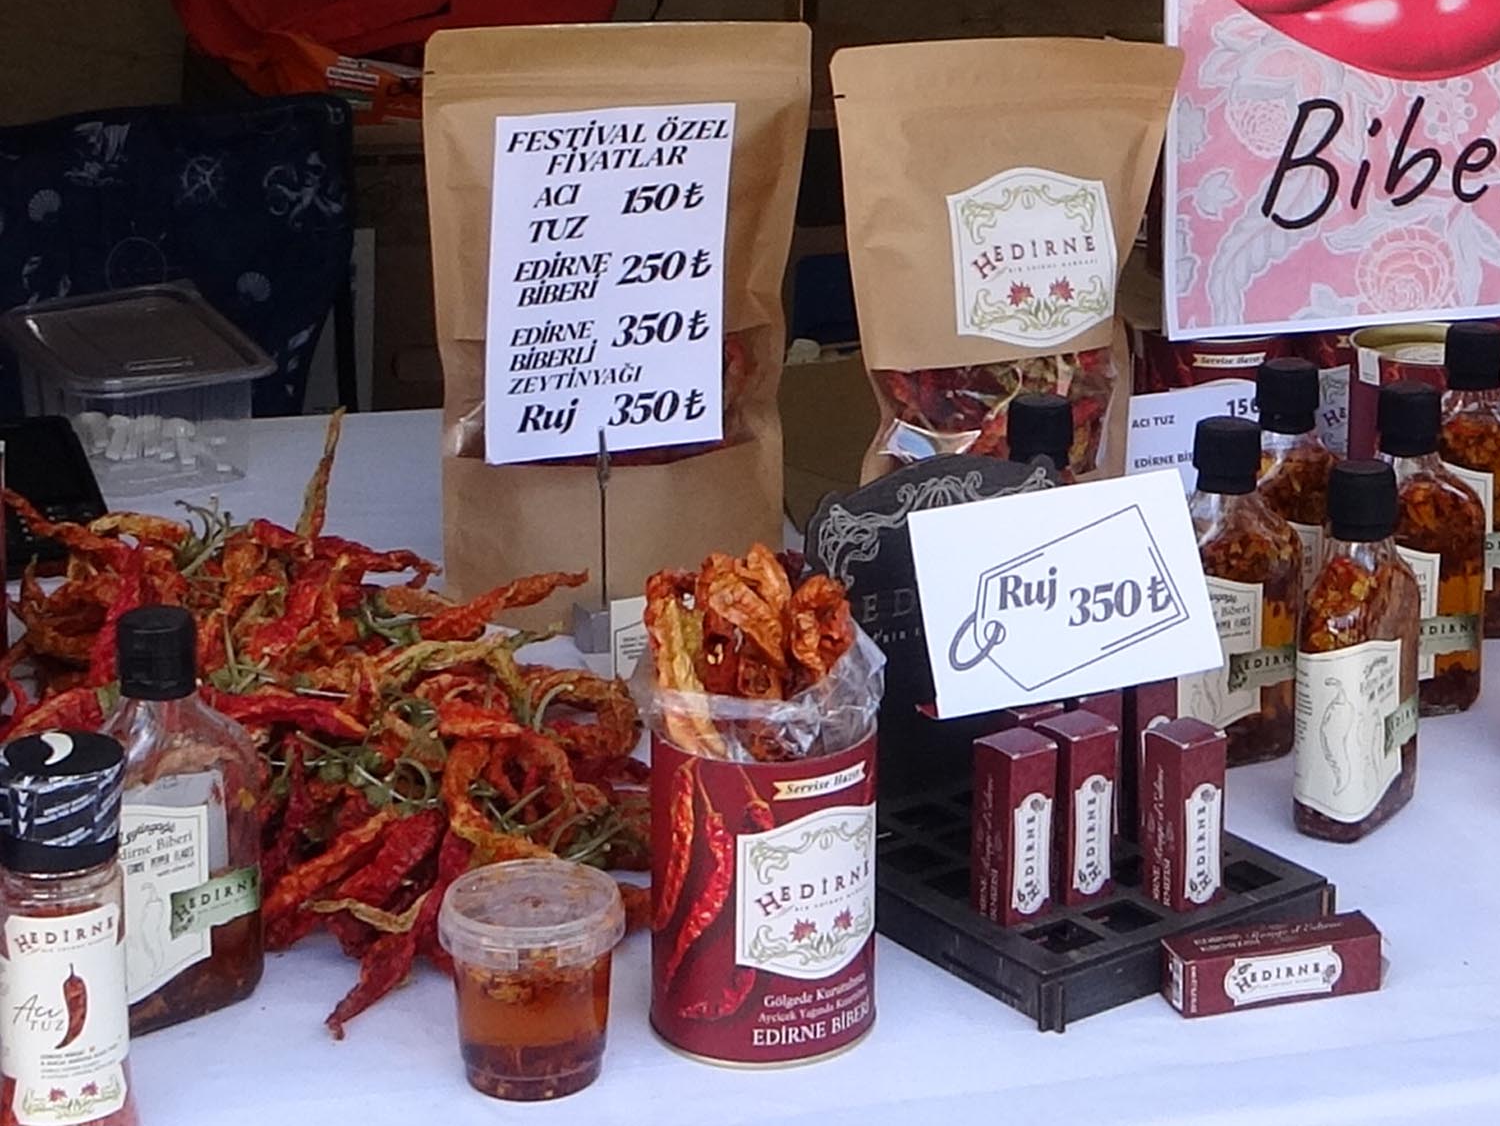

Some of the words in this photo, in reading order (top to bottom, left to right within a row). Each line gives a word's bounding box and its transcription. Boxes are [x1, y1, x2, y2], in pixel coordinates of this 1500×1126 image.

[506, 119, 647, 154] FESTİVAL
[656, 115, 729, 142] ÖZEL
[545, 145, 688, 176] FİYATLAR
[532, 183, 582, 209] ACI
[528, 214, 590, 244] TUZ
[513, 250, 613, 283] EDİRNE
[516, 273, 600, 308] BİBERİ
[509, 319, 595, 347] EDİRNE
[508, 338, 599, 373] BİBERLİ
[507, 362, 644, 396] ZEYTİNYAĞI
[516, 397, 580, 435] Ruj
[998, 565, 1058, 612] Ruj
[751, 1020, 827, 1047] EDİRNE
